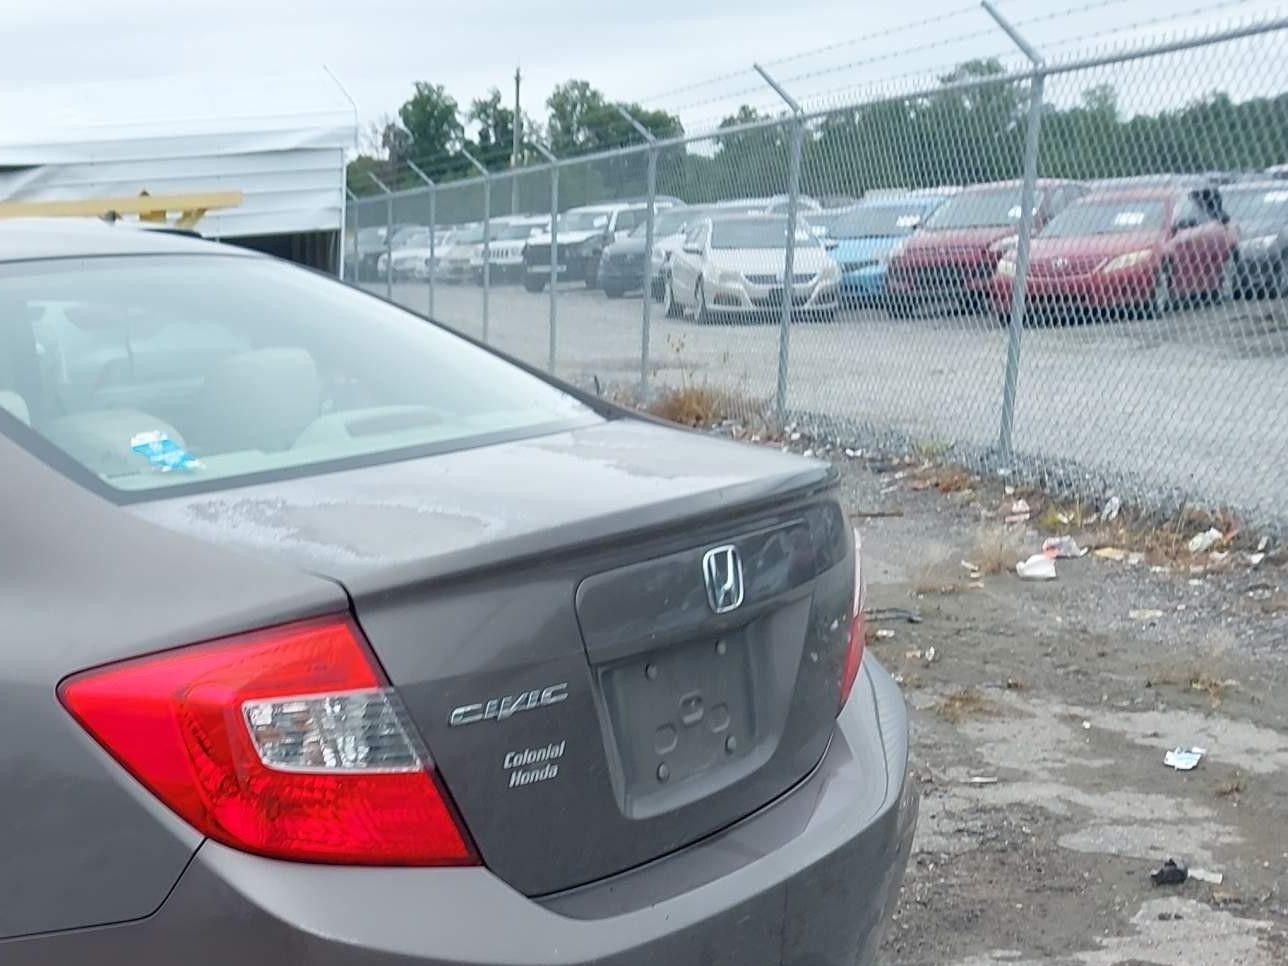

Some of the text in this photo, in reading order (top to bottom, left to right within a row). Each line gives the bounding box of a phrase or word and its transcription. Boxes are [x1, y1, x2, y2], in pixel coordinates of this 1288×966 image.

[450, 682, 569, 727] CIVIC
[503, 740, 567, 769] Colonial
[508, 763, 560, 788] Honda
